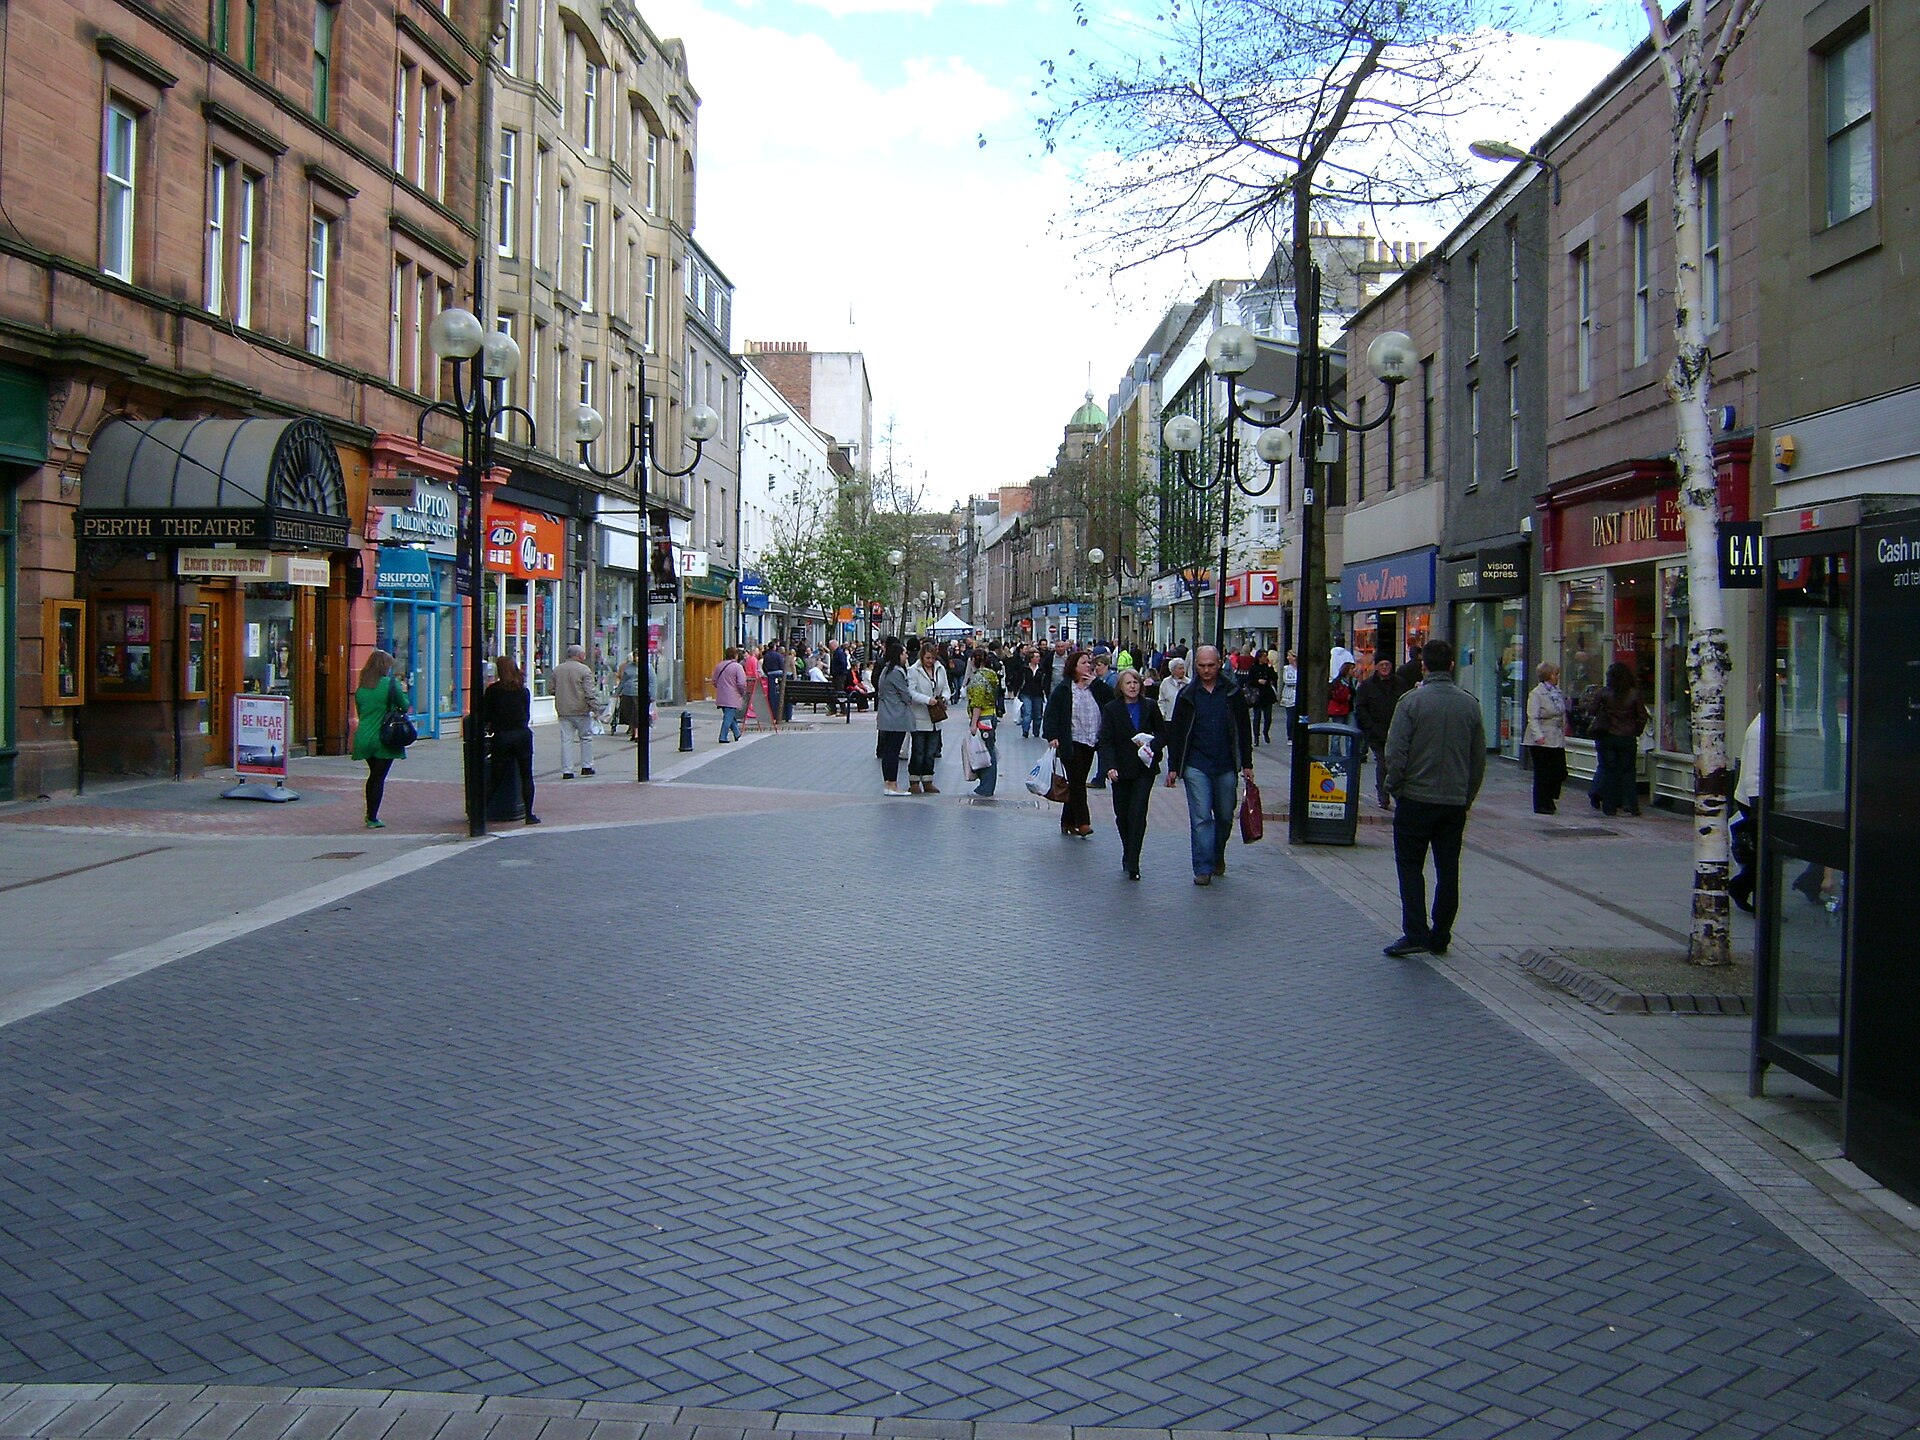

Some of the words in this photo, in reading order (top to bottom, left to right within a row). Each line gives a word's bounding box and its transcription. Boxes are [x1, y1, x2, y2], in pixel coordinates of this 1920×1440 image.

[407, 493, 450, 518] KIPTON
[83, 518, 151, 536] PERTH
[160, 518, 255, 536] THEATRE
[275, 520, 305, 540] PERTH
[308, 524, 346, 545] THEATRE
[396, 514, 430, 534] BUILDING
[432, 520, 457, 538] SOCIET
[1592, 512, 1620, 547] PAST
[1626, 505, 1657, 541] TIME
[1877, 536, 1908, 563] Cash
[1482, 570, 1518, 578] express
[1487, 562, 1514, 570] vision
[379, 573, 429, 583] SKIPTON
[1357, 572, 1380, 602] Shoe
[1381, 568, 1408, 600] Zone
[1893, 568, 1909, 587] and
[1616, 632, 1634, 651] SALE
[242, 714, 253, 727] BE
[256, 715, 282, 728] NEAR
[267, 729, 282, 740] ME
